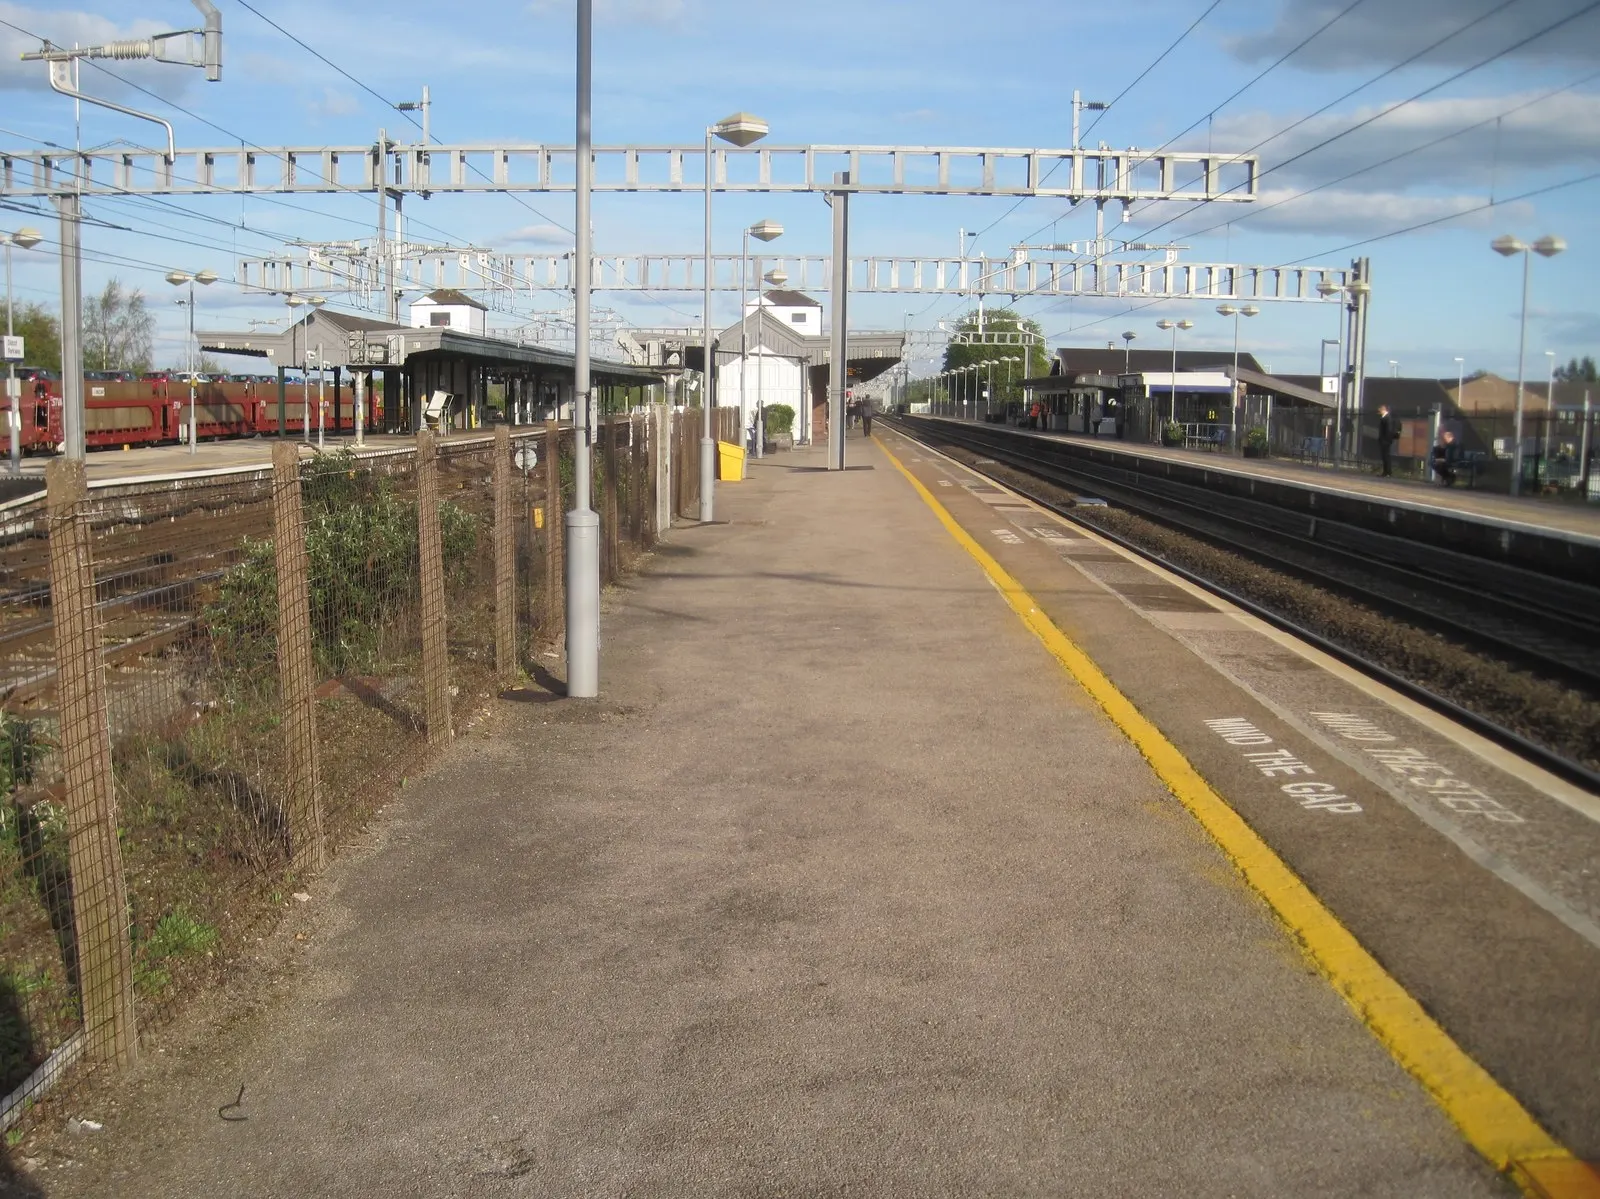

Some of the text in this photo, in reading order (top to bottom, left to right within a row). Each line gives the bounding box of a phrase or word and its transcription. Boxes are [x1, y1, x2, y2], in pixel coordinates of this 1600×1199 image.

[1201, 717, 1364, 814] MIND THE GAP
[1308, 711, 1525, 823] MIND THE STEP
